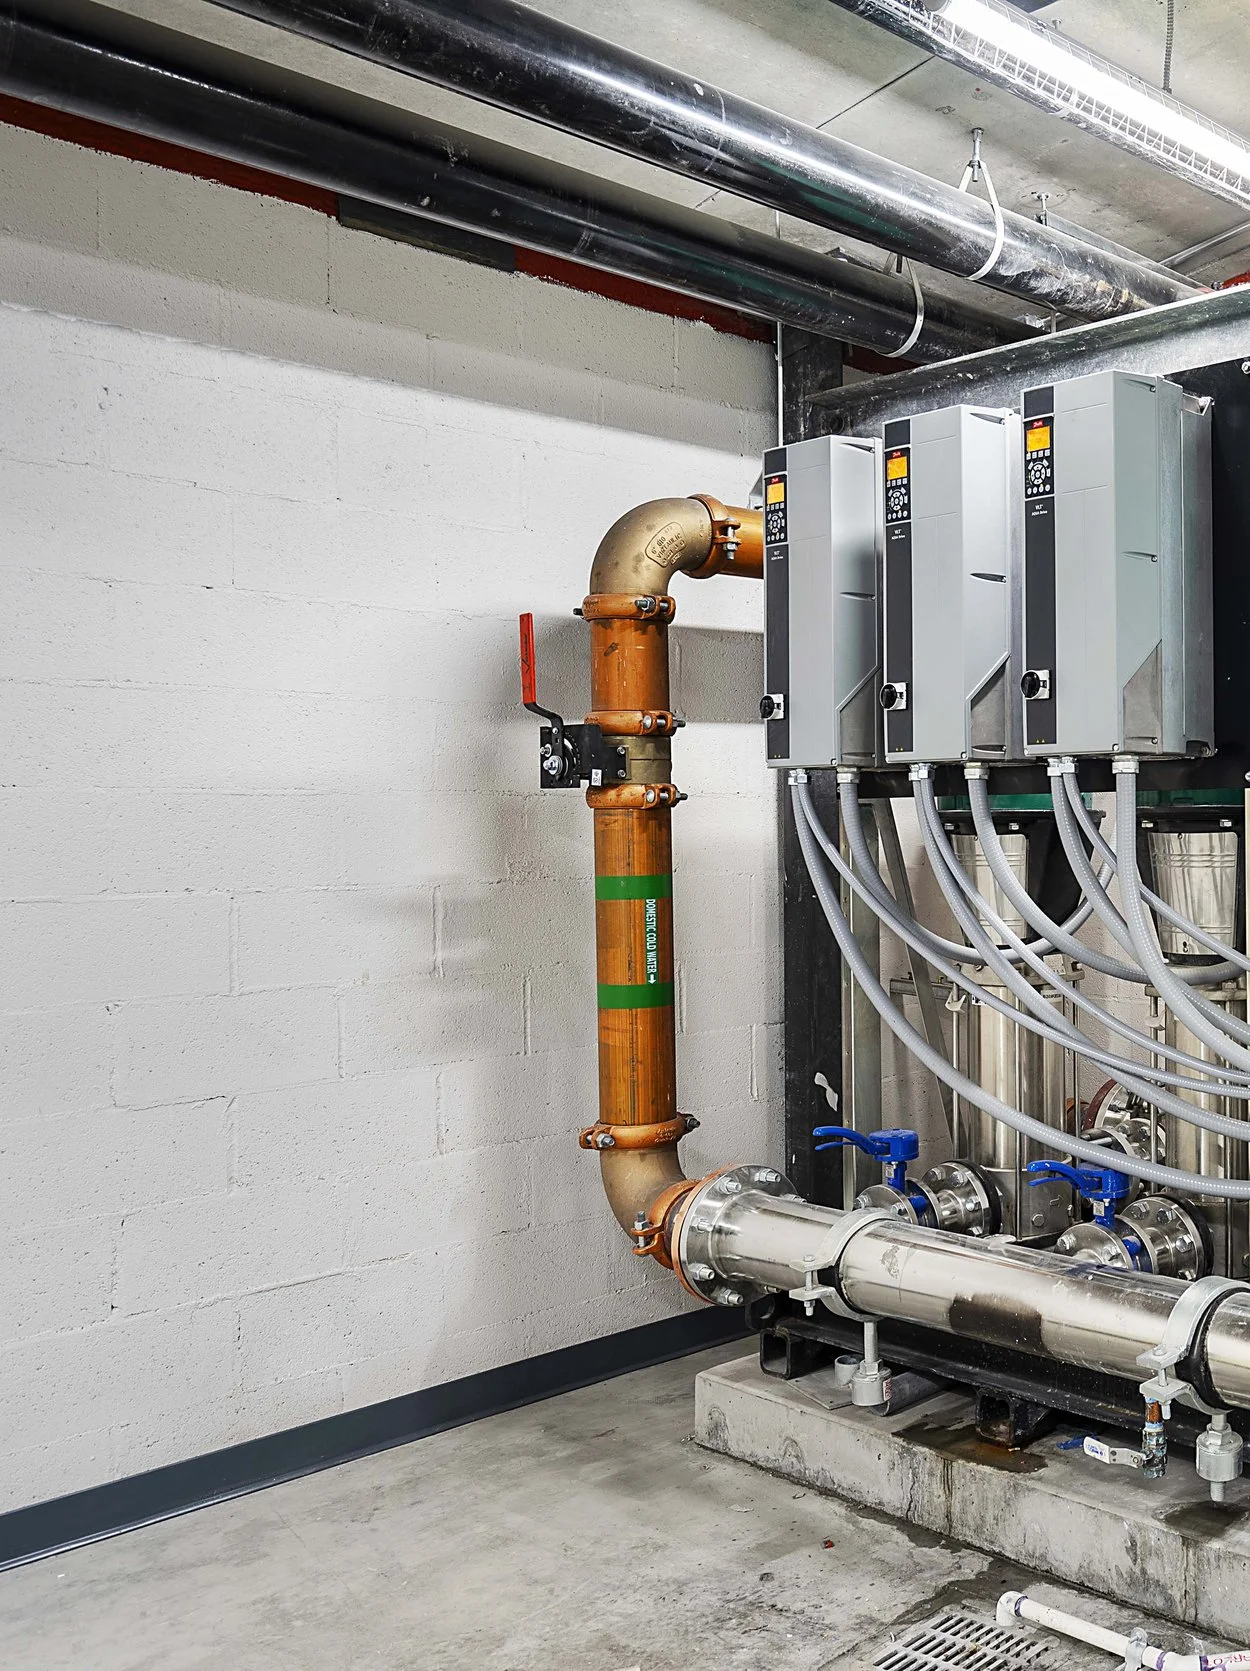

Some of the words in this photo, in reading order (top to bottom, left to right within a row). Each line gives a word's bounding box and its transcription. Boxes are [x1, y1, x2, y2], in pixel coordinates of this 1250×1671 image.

[645, 898, 657, 932] DOMESTIC
[646, 932, 657, 950] COLD
[646, 950, 658, 974] WATER
